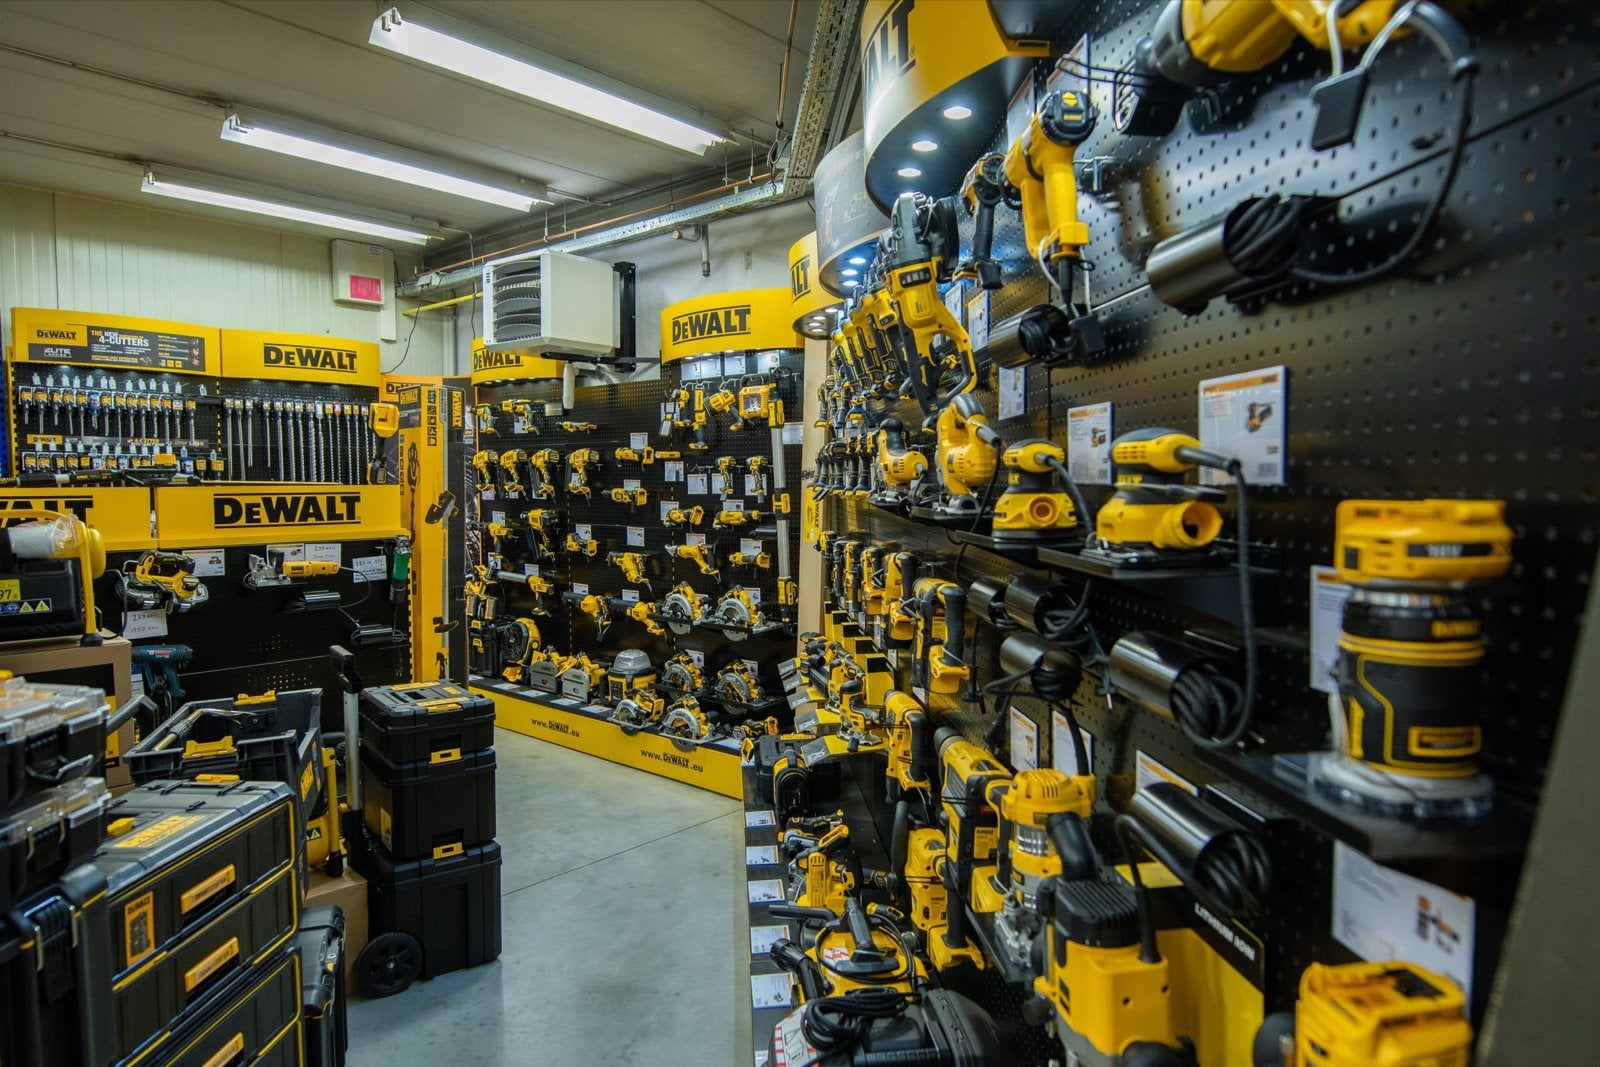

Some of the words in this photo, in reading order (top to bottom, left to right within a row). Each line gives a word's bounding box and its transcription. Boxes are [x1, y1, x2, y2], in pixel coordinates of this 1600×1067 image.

[36, 329, 77, 340] DEWALT
[672, 307, 751, 343] DEWALT
[98, 335, 149, 348] 4-CUTTERS
[264, 345, 358, 371] DEWALT
[214, 495, 361, 525] DEWALT
